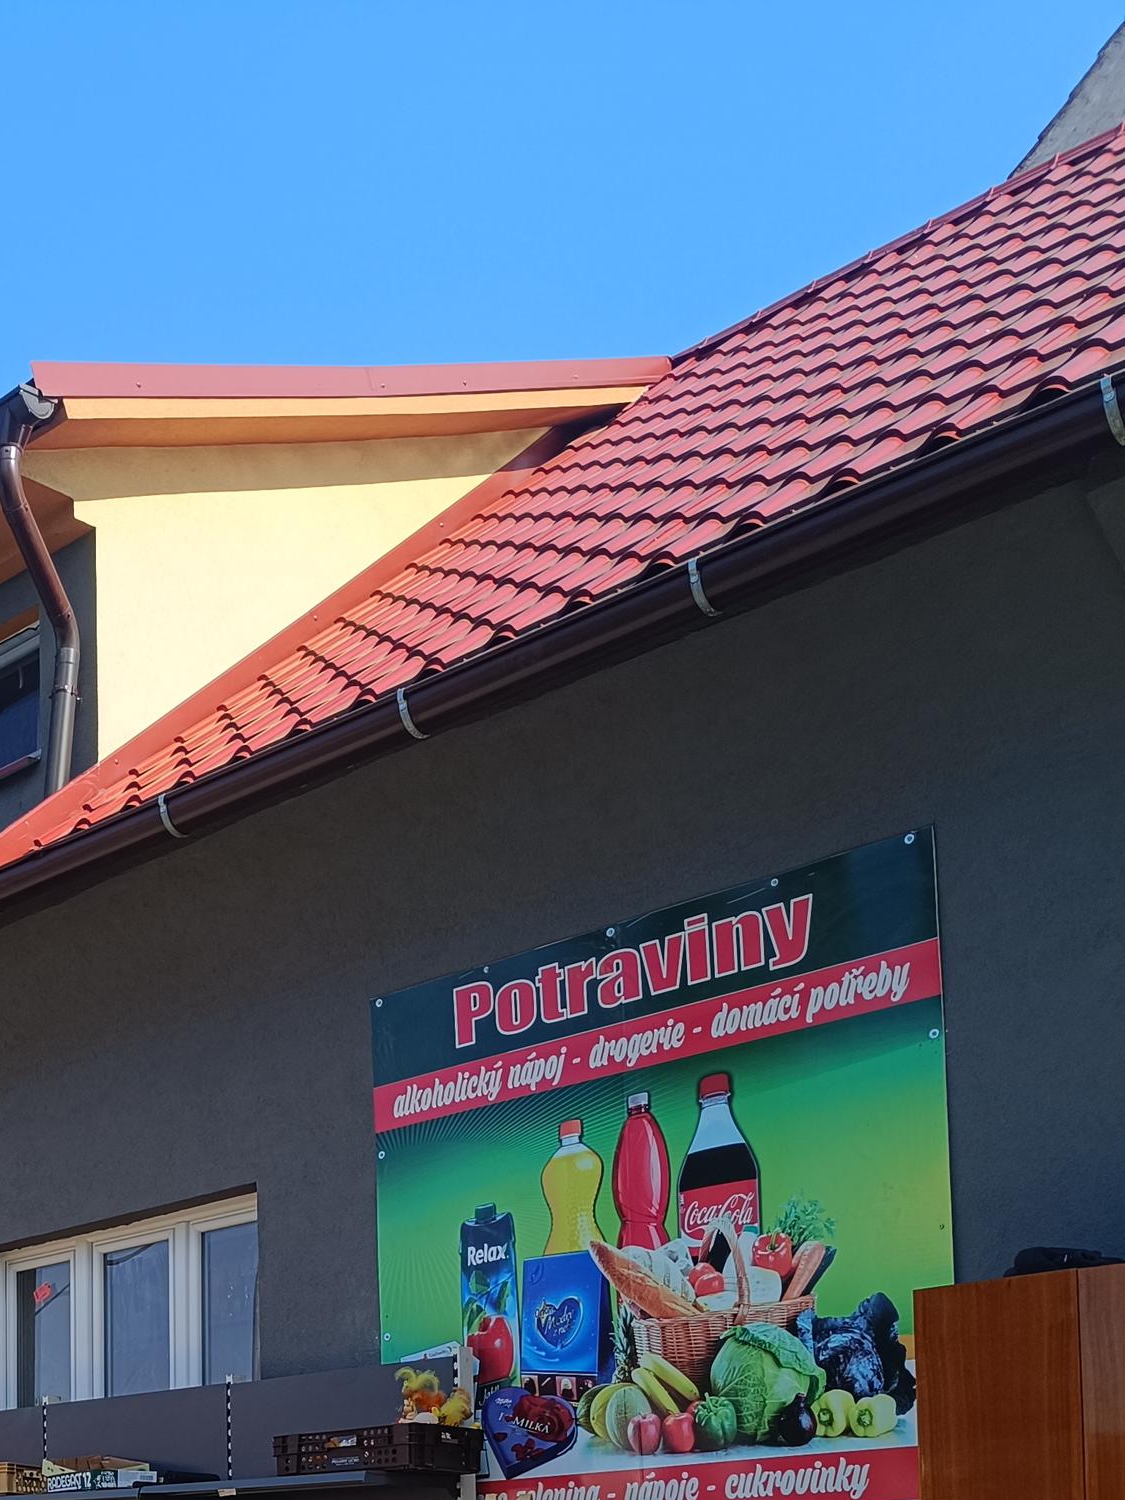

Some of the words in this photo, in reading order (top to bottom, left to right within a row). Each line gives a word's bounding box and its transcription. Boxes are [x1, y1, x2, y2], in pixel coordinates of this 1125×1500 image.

[453, 893, 813, 1048] Potraviny
[393, 1060, 502, 1119] alkoholický
[507, 1047, 568, 1096] nápoj
[588, 1018, 686, 1072] drogerie
[710, 984, 801, 1039] domácí
[806, 960, 911, 1021] potřeby
[467, 1243, 508, 1267] Relax
[513, 1417, 550, 1434] MILKA
